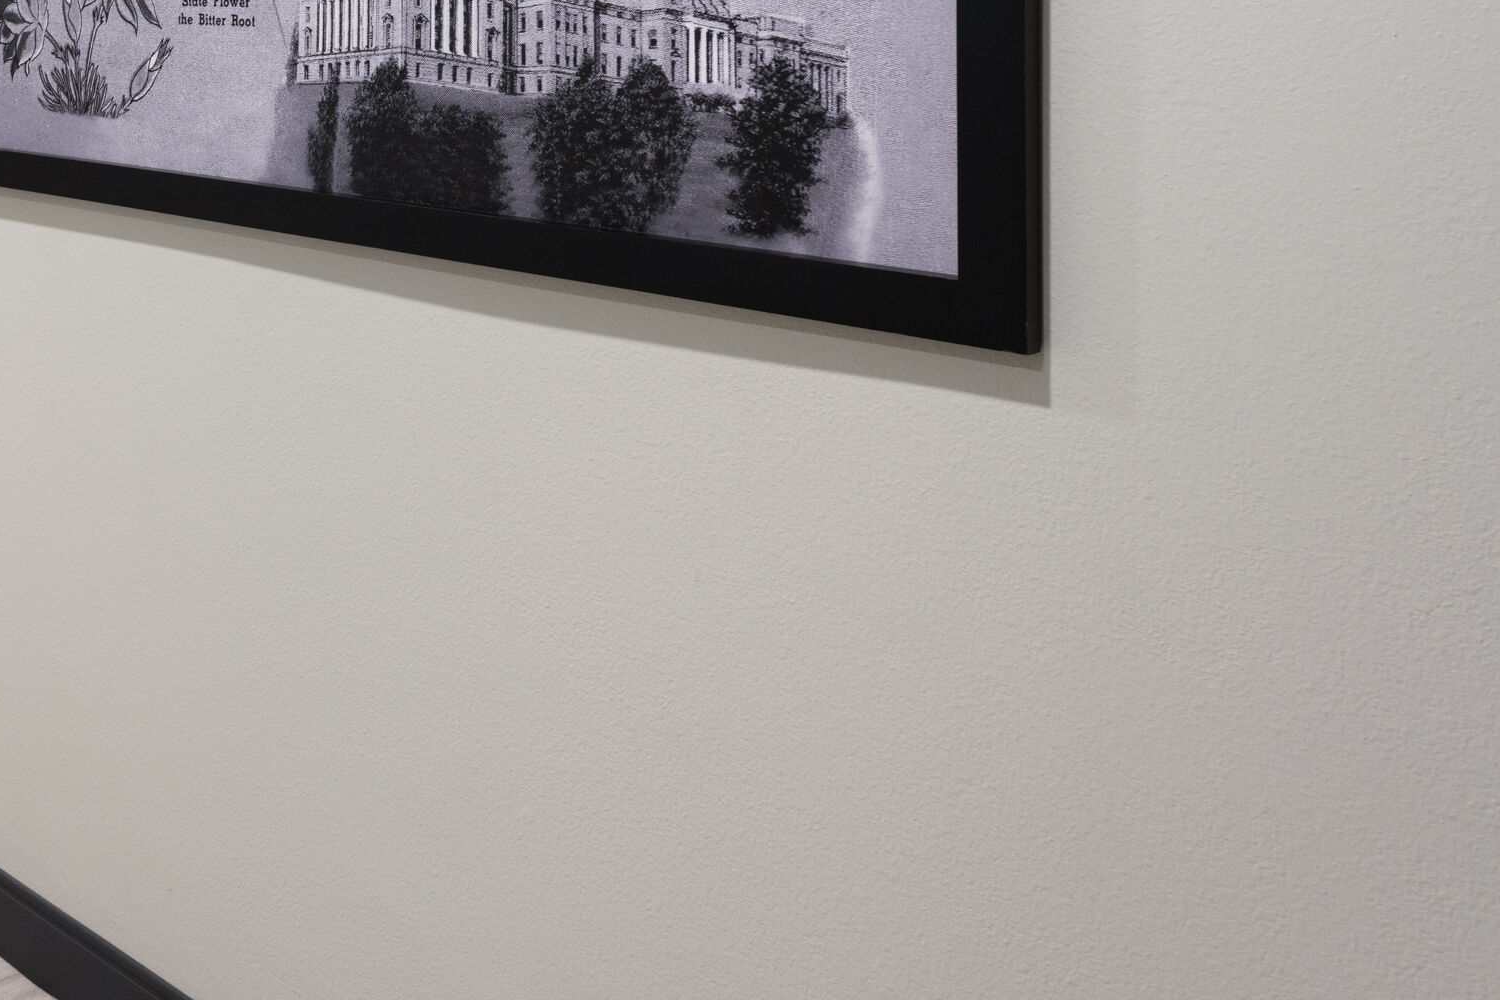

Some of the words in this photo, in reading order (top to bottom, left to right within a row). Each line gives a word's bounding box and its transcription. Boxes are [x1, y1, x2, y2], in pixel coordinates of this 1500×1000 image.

[178, 12, 193, 25] the
[198, 13, 226, 26] Bitter
[231, 13, 256, 27] Root
